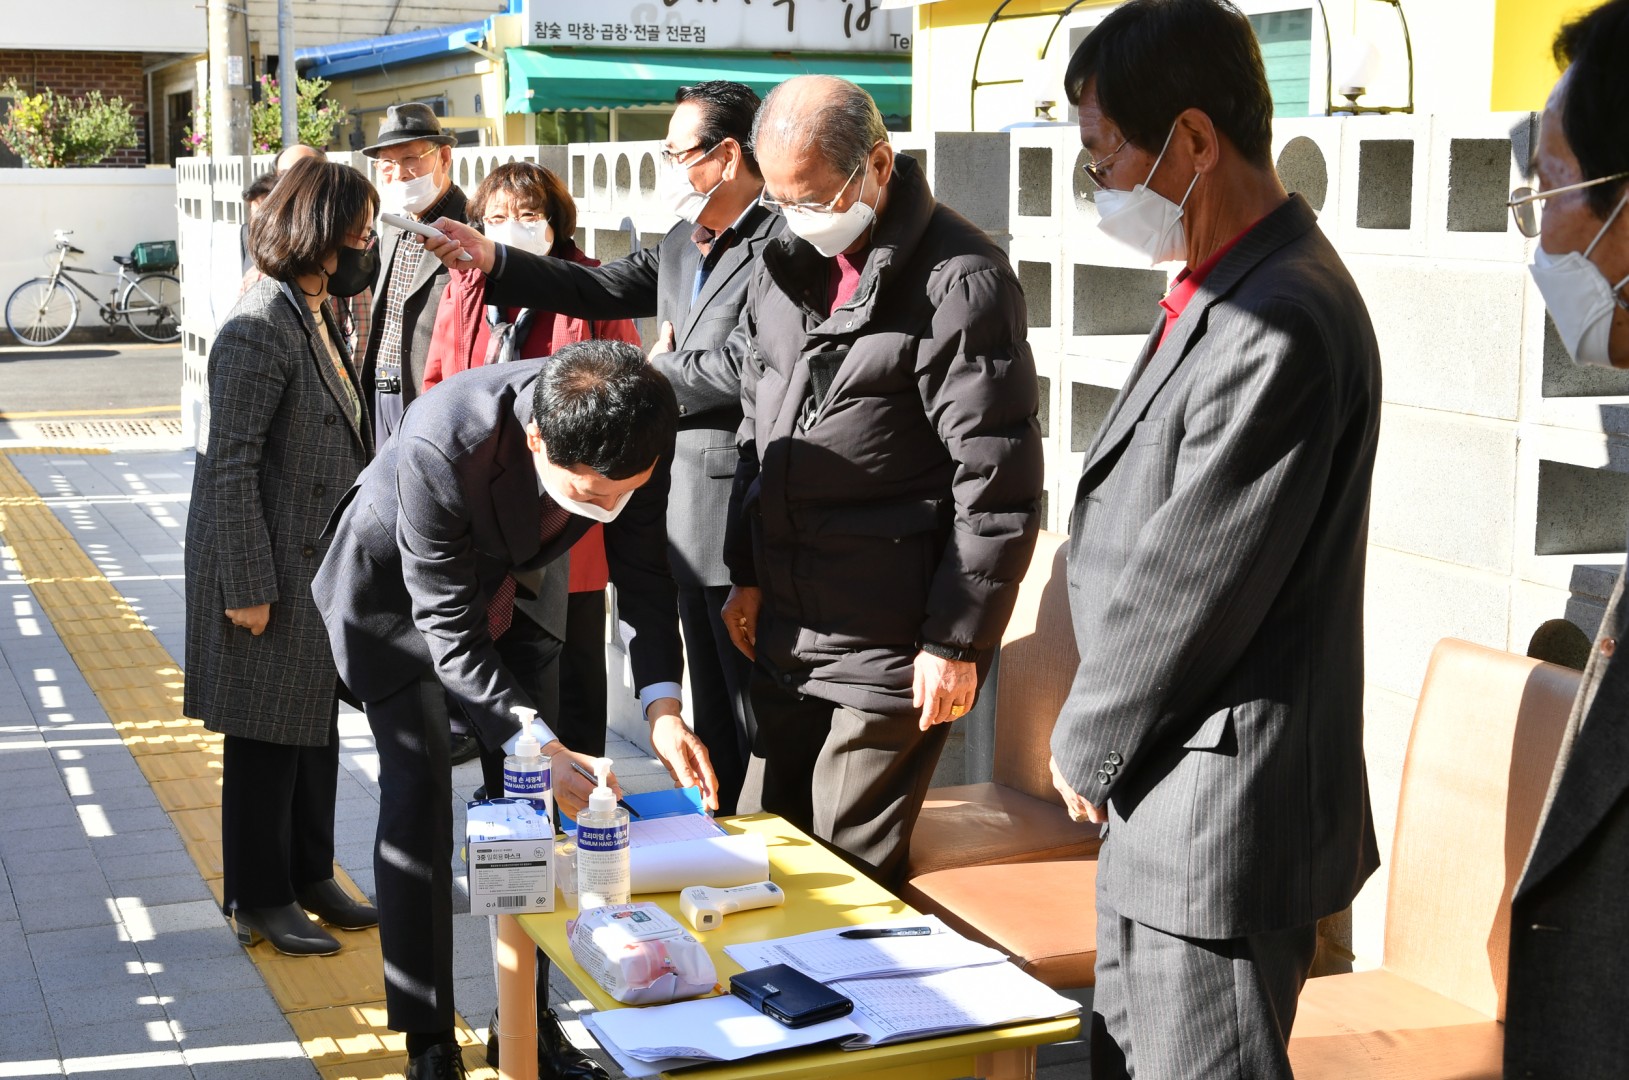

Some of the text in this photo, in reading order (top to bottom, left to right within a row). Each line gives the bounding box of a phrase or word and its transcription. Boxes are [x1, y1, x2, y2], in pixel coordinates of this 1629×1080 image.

[534, 21, 706, 43] 참숯 막창·곱창·전골 전문점
[582, 831, 605, 841] 프리미엄
[605, 833, 613, 841] 손
[579, 838, 598, 847] PREMIUM
[598, 840, 614, 848] HAND
[504, 852, 521, 860] 마스크
